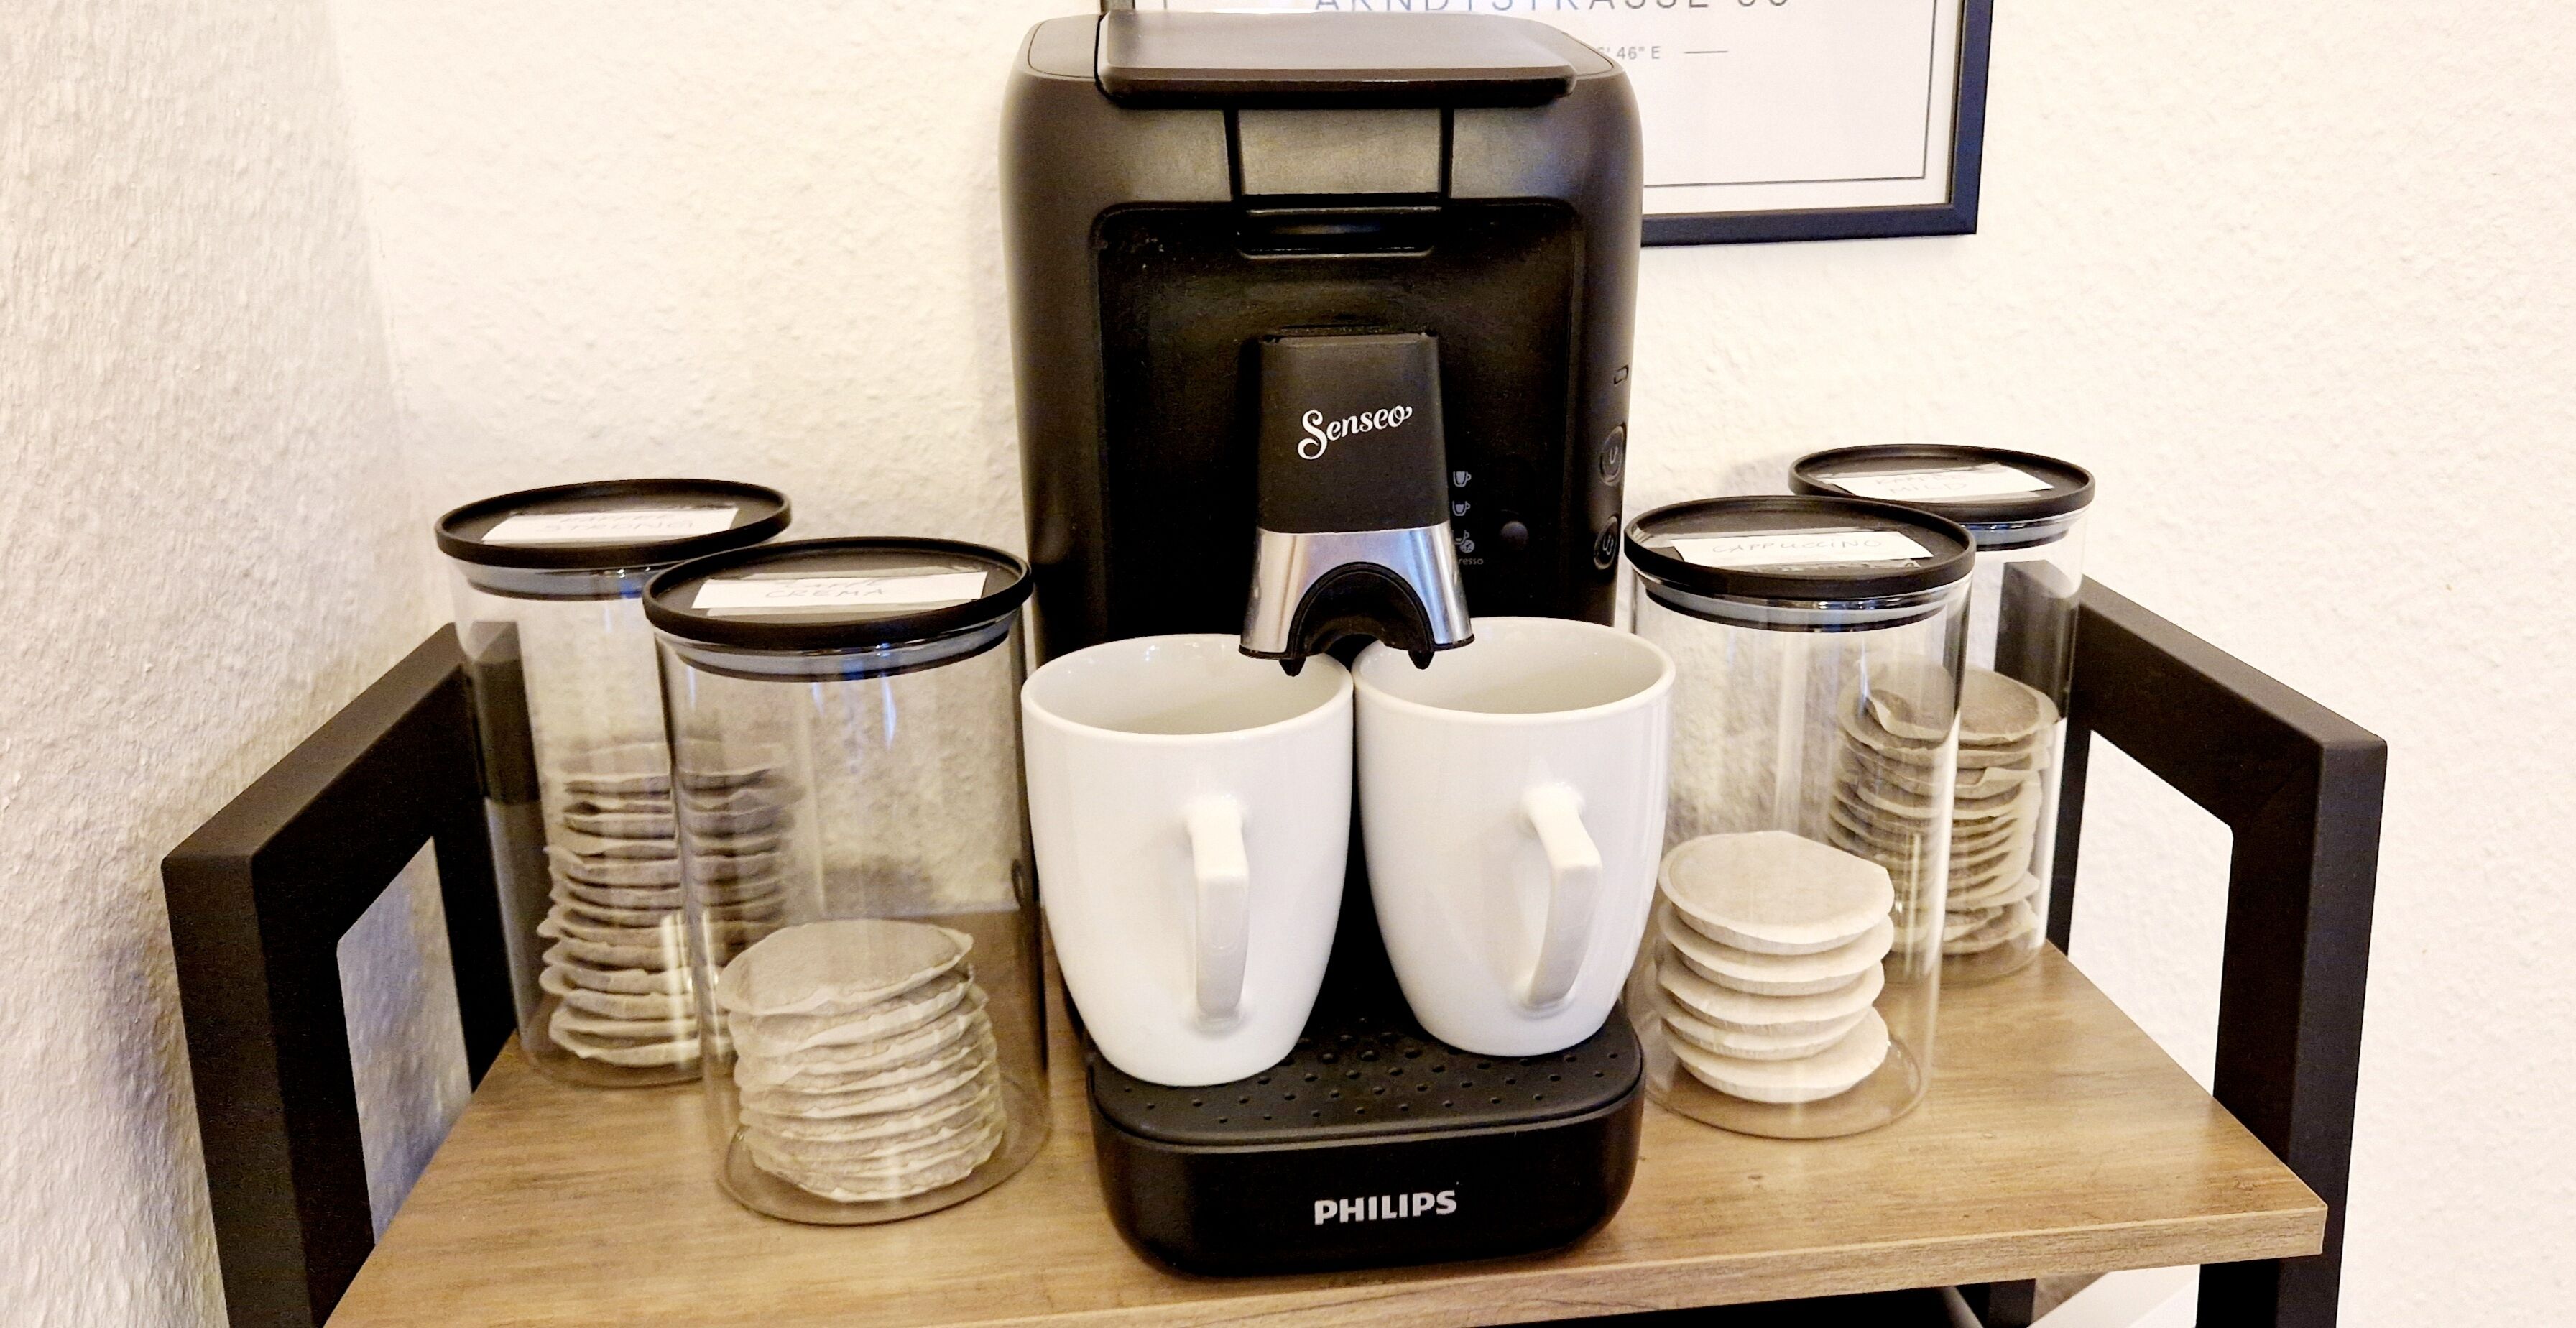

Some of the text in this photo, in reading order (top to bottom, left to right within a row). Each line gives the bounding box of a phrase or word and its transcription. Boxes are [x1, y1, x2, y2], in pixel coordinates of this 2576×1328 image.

[1651, 45, 1661, 60] E
[1297, 405, 1413, 460] Senseo
[1712, 539, 1882, 553] CAPPUCCINO
[765, 588, 885, 598] CREMA
[1314, 1190, 1457, 1225] PHILIPS
